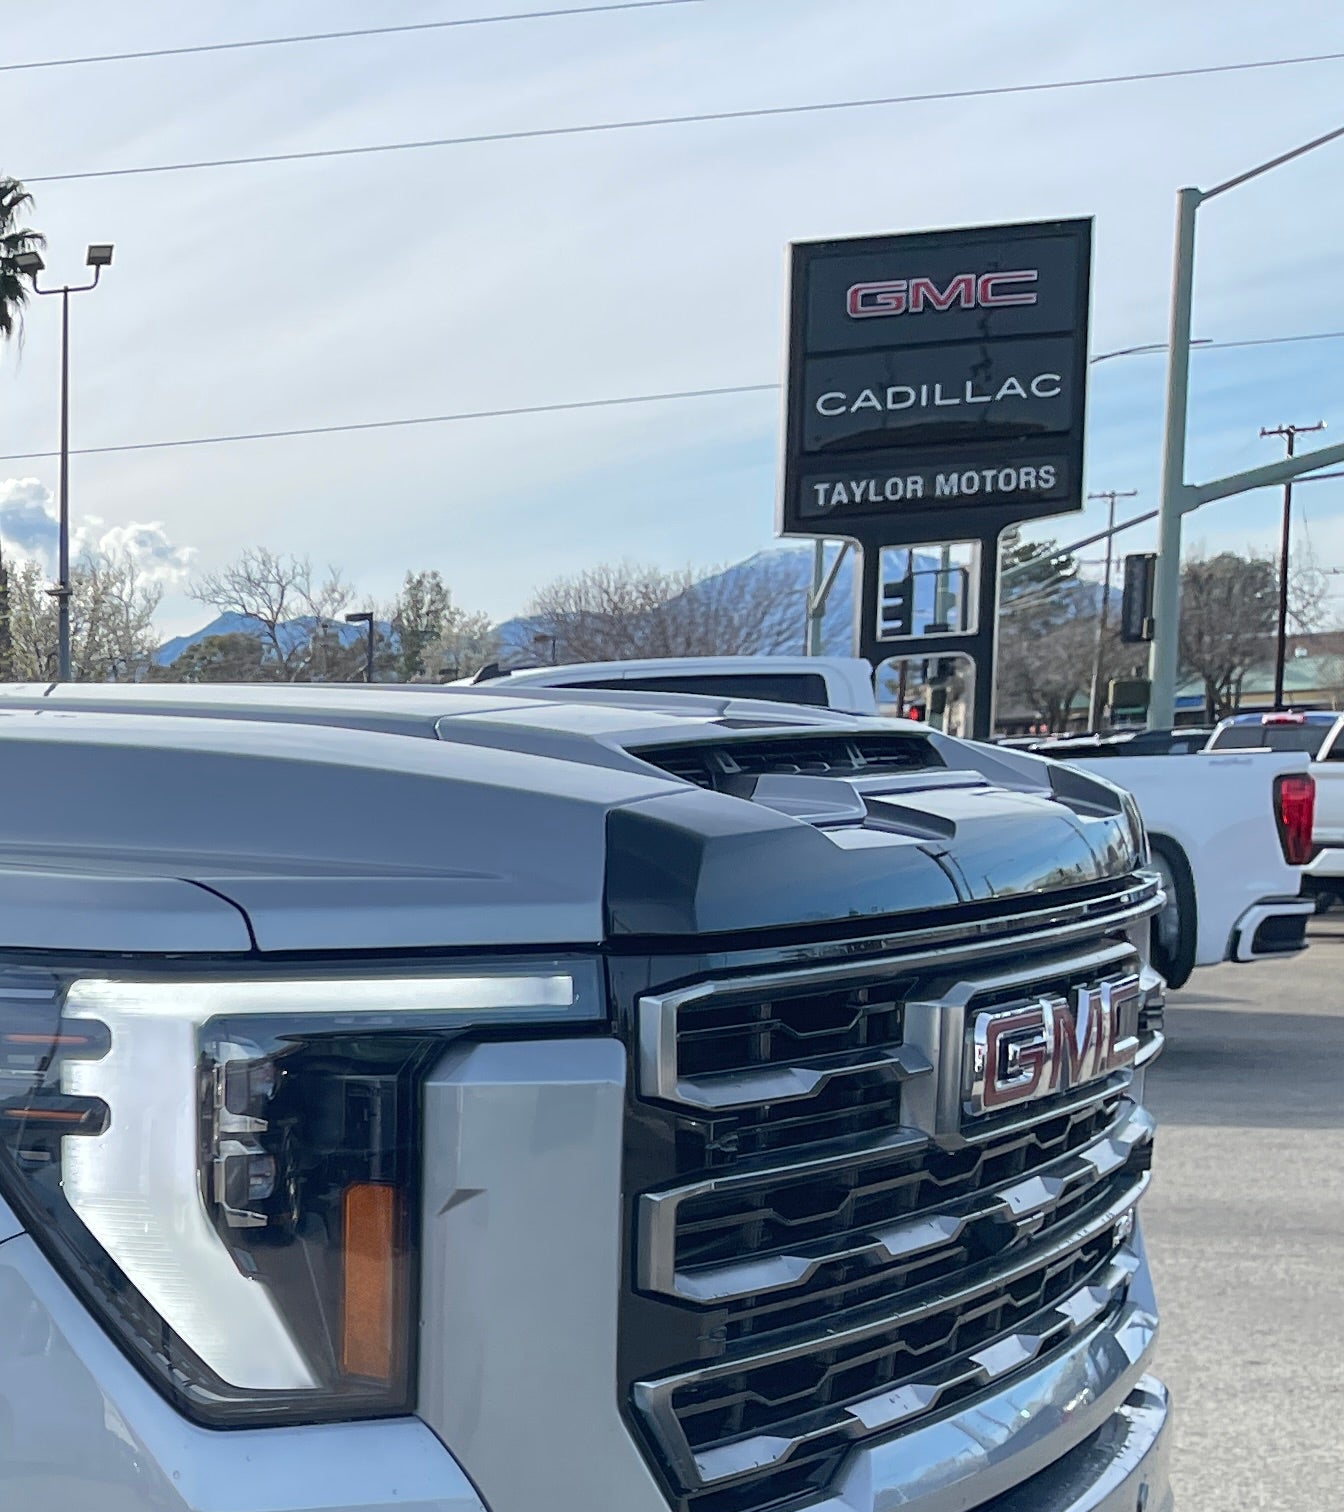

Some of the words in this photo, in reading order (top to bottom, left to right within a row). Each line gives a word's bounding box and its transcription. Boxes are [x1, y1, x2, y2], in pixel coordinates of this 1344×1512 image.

[846, 269, 1038, 320] GMC
[815, 372, 1063, 417] CADILLAC
[813, 474, 924, 507] TAYLOR
[935, 464, 1057, 497] MOTORS
[973, 973, 1139, 1116] GMC
